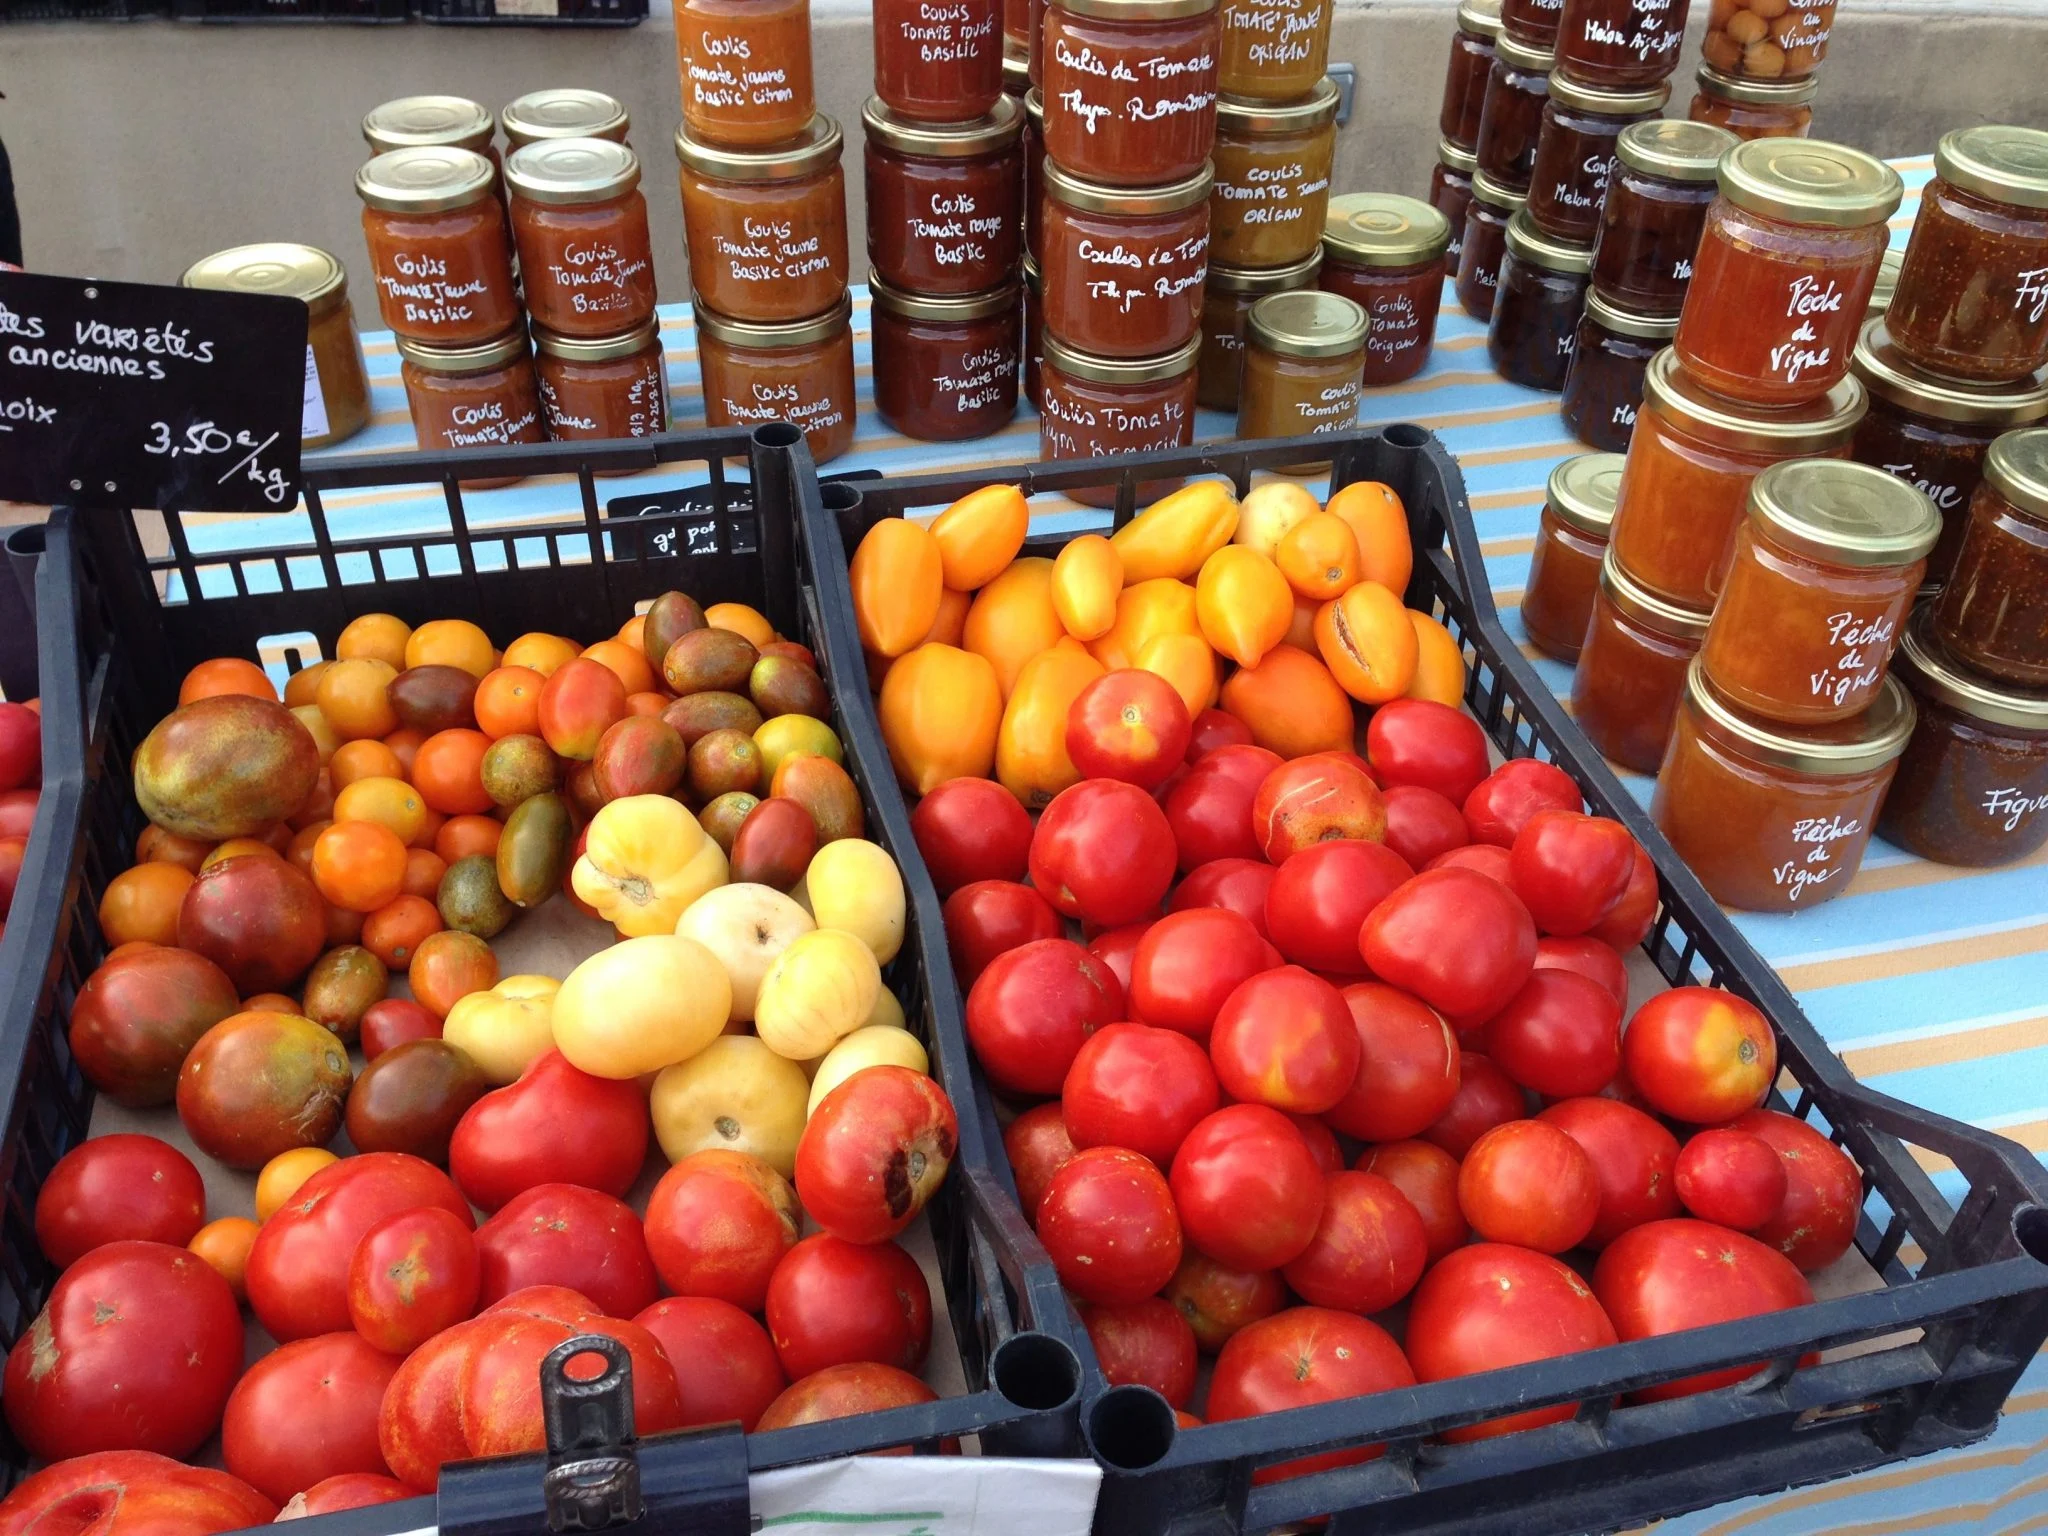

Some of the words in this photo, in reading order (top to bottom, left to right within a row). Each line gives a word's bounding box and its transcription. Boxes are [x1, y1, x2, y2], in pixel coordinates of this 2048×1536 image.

[702, 31, 751, 59] Coulis
[683, 57, 737, 85] Tomate
[1056, 39, 1108, 76] Coulis
[1111, 60, 1139, 82] de
[931, 193, 976, 215] Coulis
[743, 216, 791, 239] Coulis
[907, 218, 966, 238] Tomate
[969, 216, 1002, 239] rouge
[565, 241, 617, 265] Coulis
[712, 235, 771, 258] Tomate
[774, 237, 818, 264] jaune
[935, 241, 985, 265] Basilic
[1079, 240, 1143, 268] Coulis
[394, 253, 446, 278] Coulis
[548, 263, 613, 286] Tomate
[1787, 275, 1842, 317] Pêche
[405, 304, 472, 324] Basilic
[1791, 320, 1816, 342] de
[8, 344, 166, 381] anciennes
[1771, 345, 1830, 383] Vigne
[452, 402, 503, 425] Coulis
[722, 398, 781, 419] Tomate
[1100, 401, 1186, 432] Tomate
[442, 425, 499, 448] Tomate
[1827, 611, 1893, 646] Pêche
[1838, 649, 1864, 670] de
[1810, 666, 1879, 706] Vigne
[1792, 816, 1863, 843] Pêche
[1807, 845, 1830, 863] de
[1773, 862, 1841, 901] Vigne
